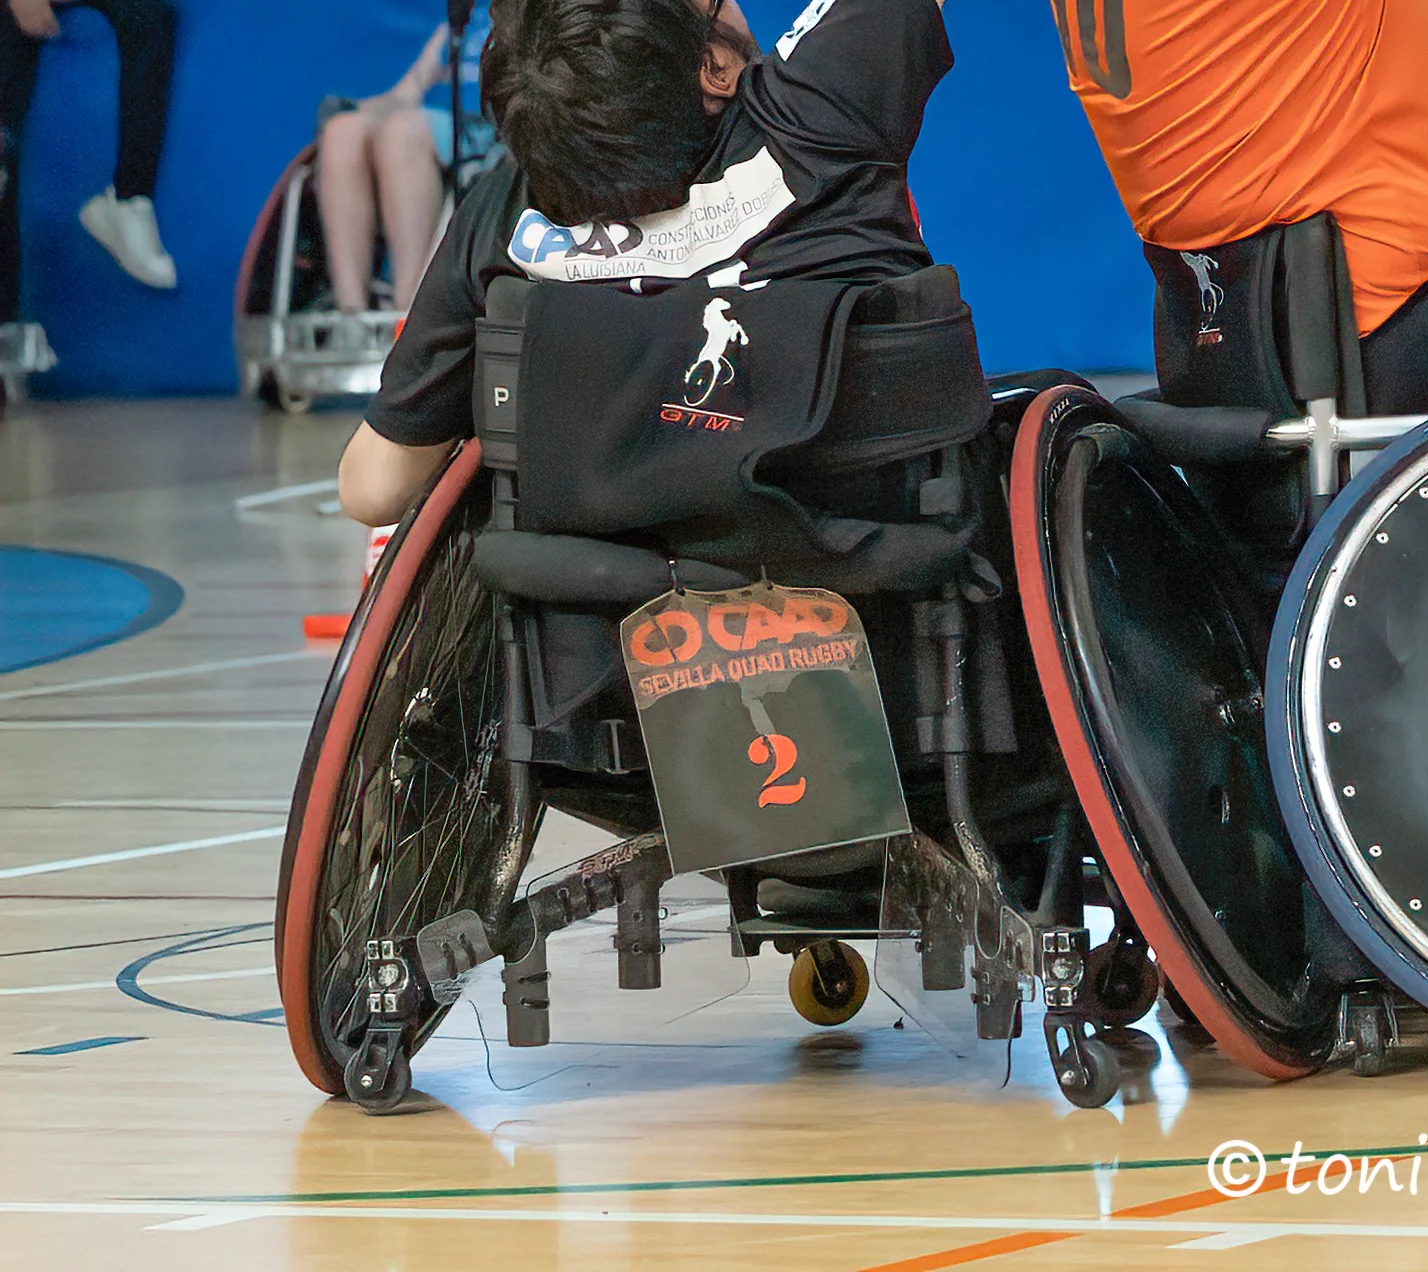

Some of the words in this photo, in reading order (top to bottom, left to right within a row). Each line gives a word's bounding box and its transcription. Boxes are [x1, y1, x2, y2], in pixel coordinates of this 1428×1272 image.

[638, 664, 725, 698] SEVILLA
[789, 638, 858, 670] RUGBY
[748, 733, 807, 809] 2
